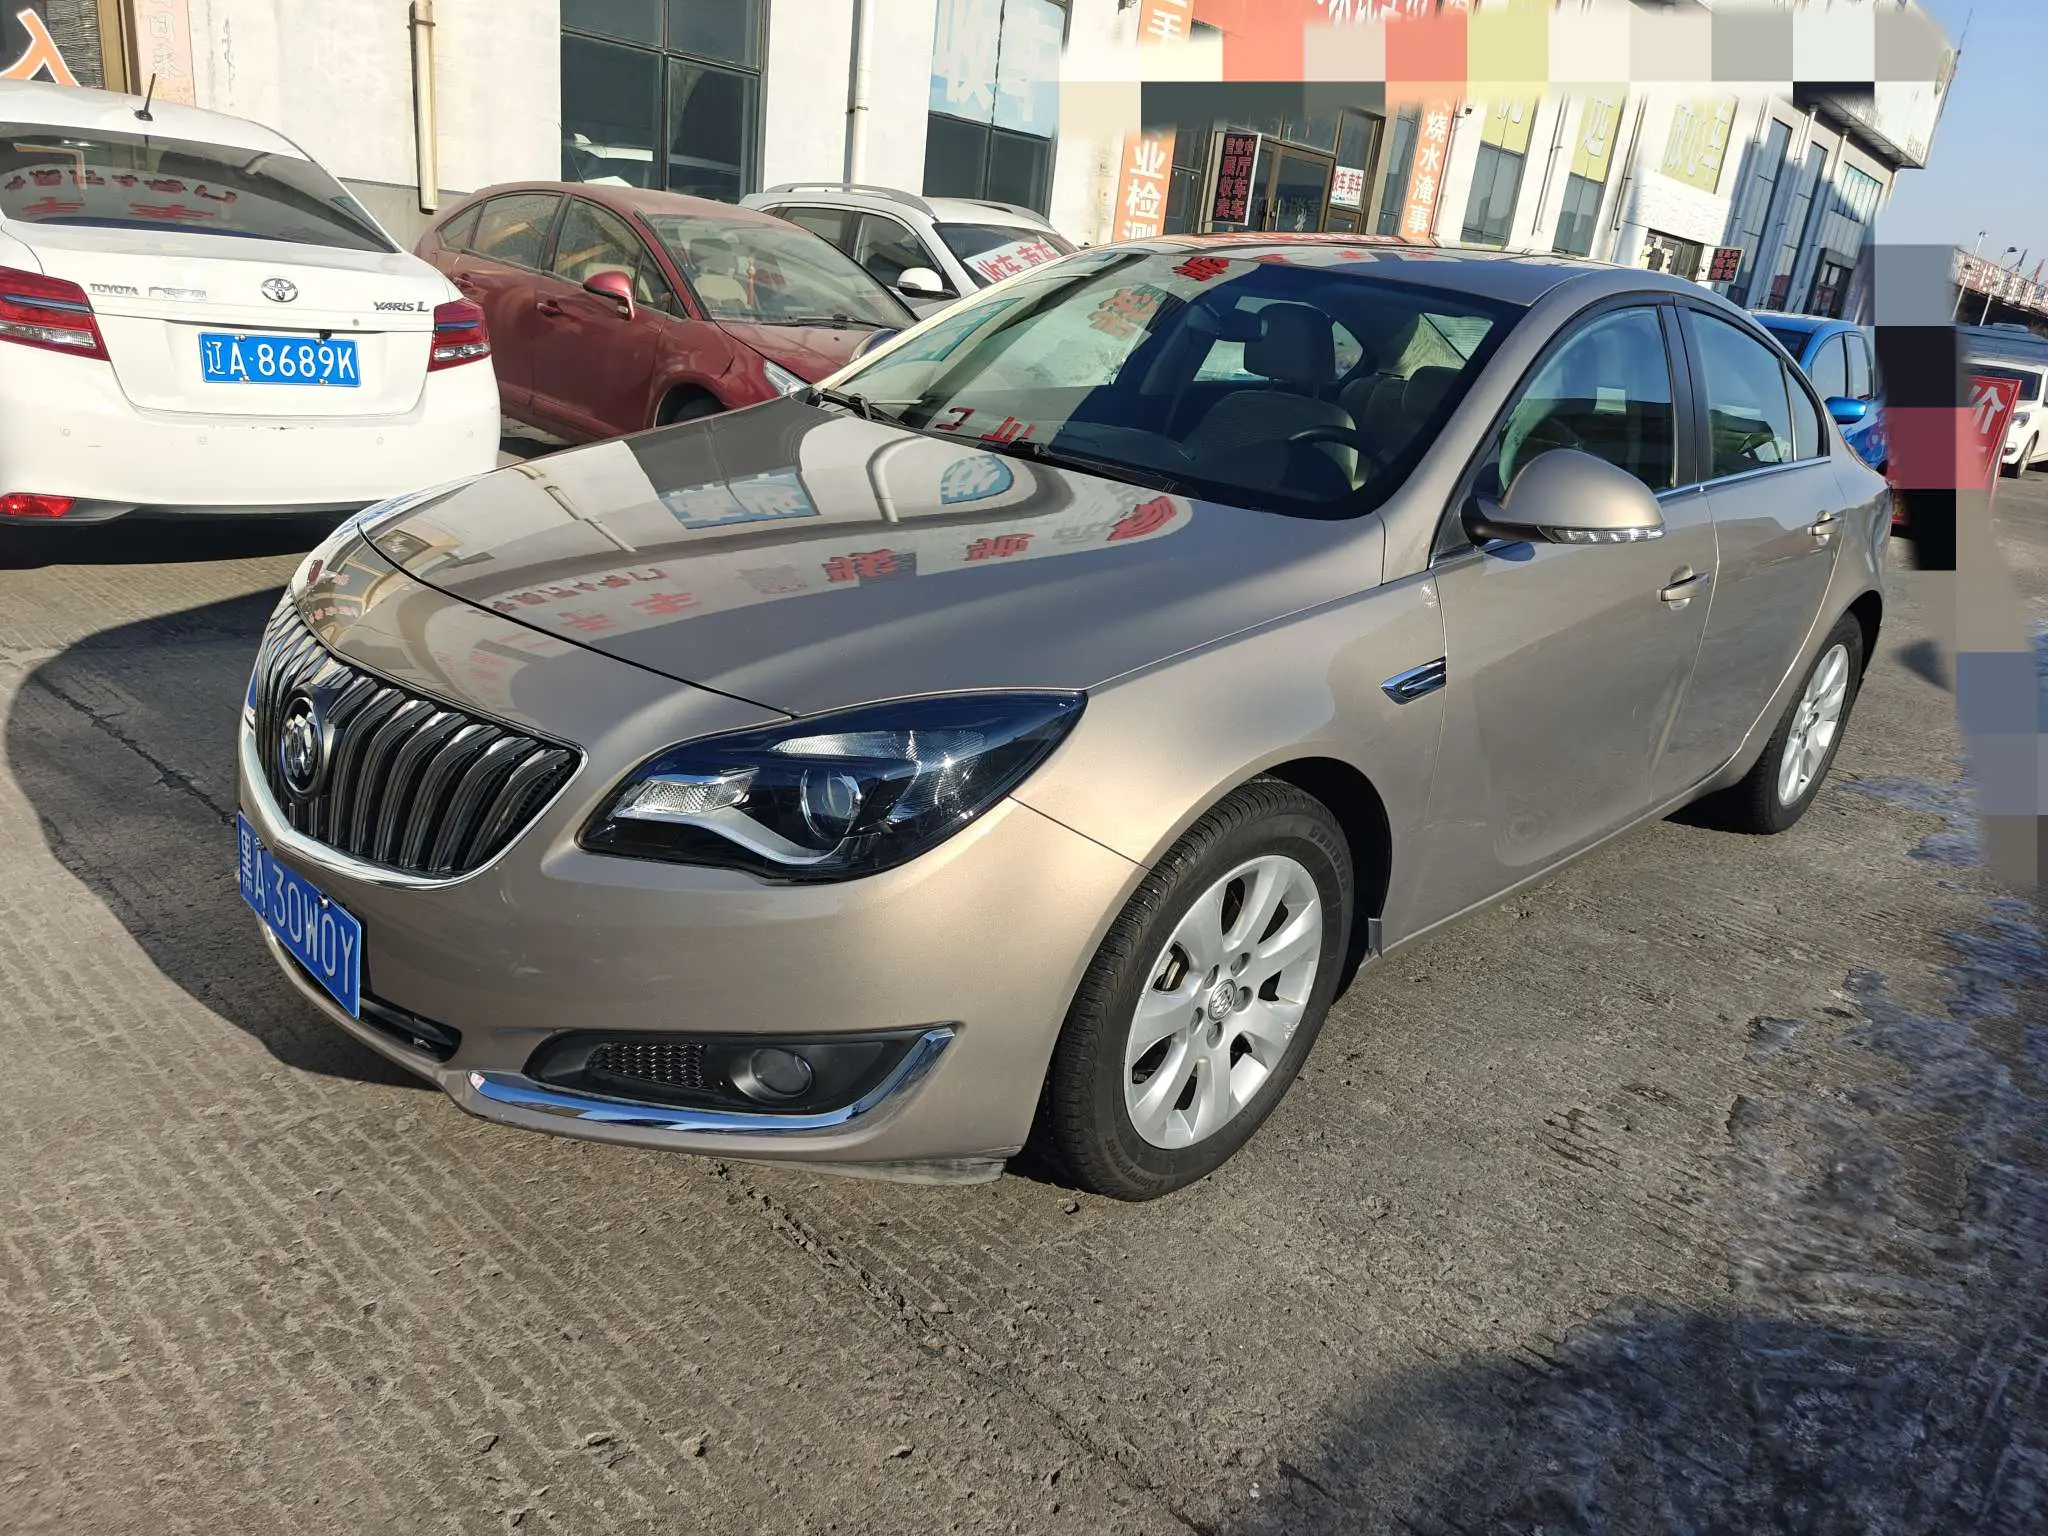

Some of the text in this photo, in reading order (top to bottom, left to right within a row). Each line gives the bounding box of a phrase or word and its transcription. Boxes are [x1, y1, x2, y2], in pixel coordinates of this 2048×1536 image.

[1407, 103, 1450, 233] 烧水淹事
[90, 283, 139, 296] TOYOTA
[417, 301, 430, 313] L
